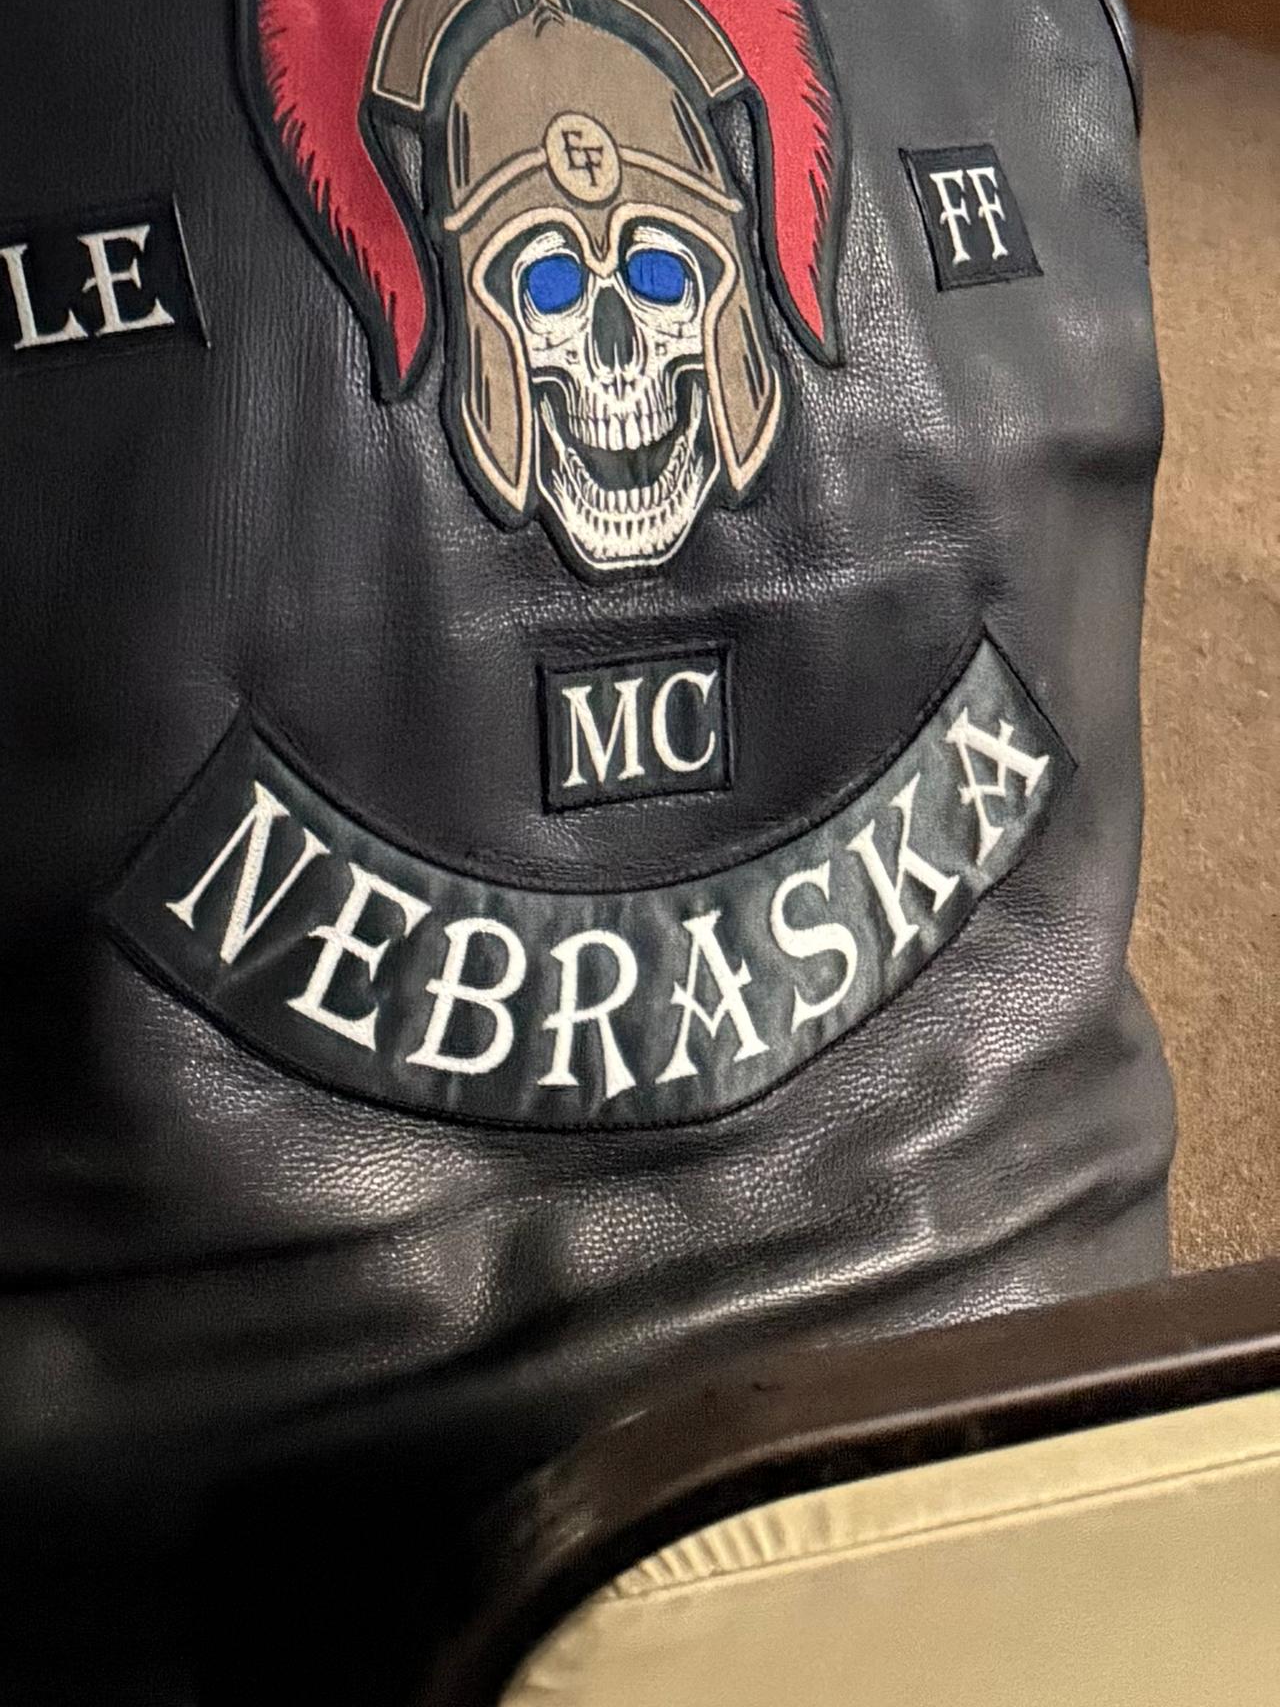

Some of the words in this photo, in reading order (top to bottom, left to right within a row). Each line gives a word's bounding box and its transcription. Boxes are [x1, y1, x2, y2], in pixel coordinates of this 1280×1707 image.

[929, 166, 1009, 266] FF
[559, 670, 718, 788] MC
[163, 706, 1050, 1101] NEBRASKA
